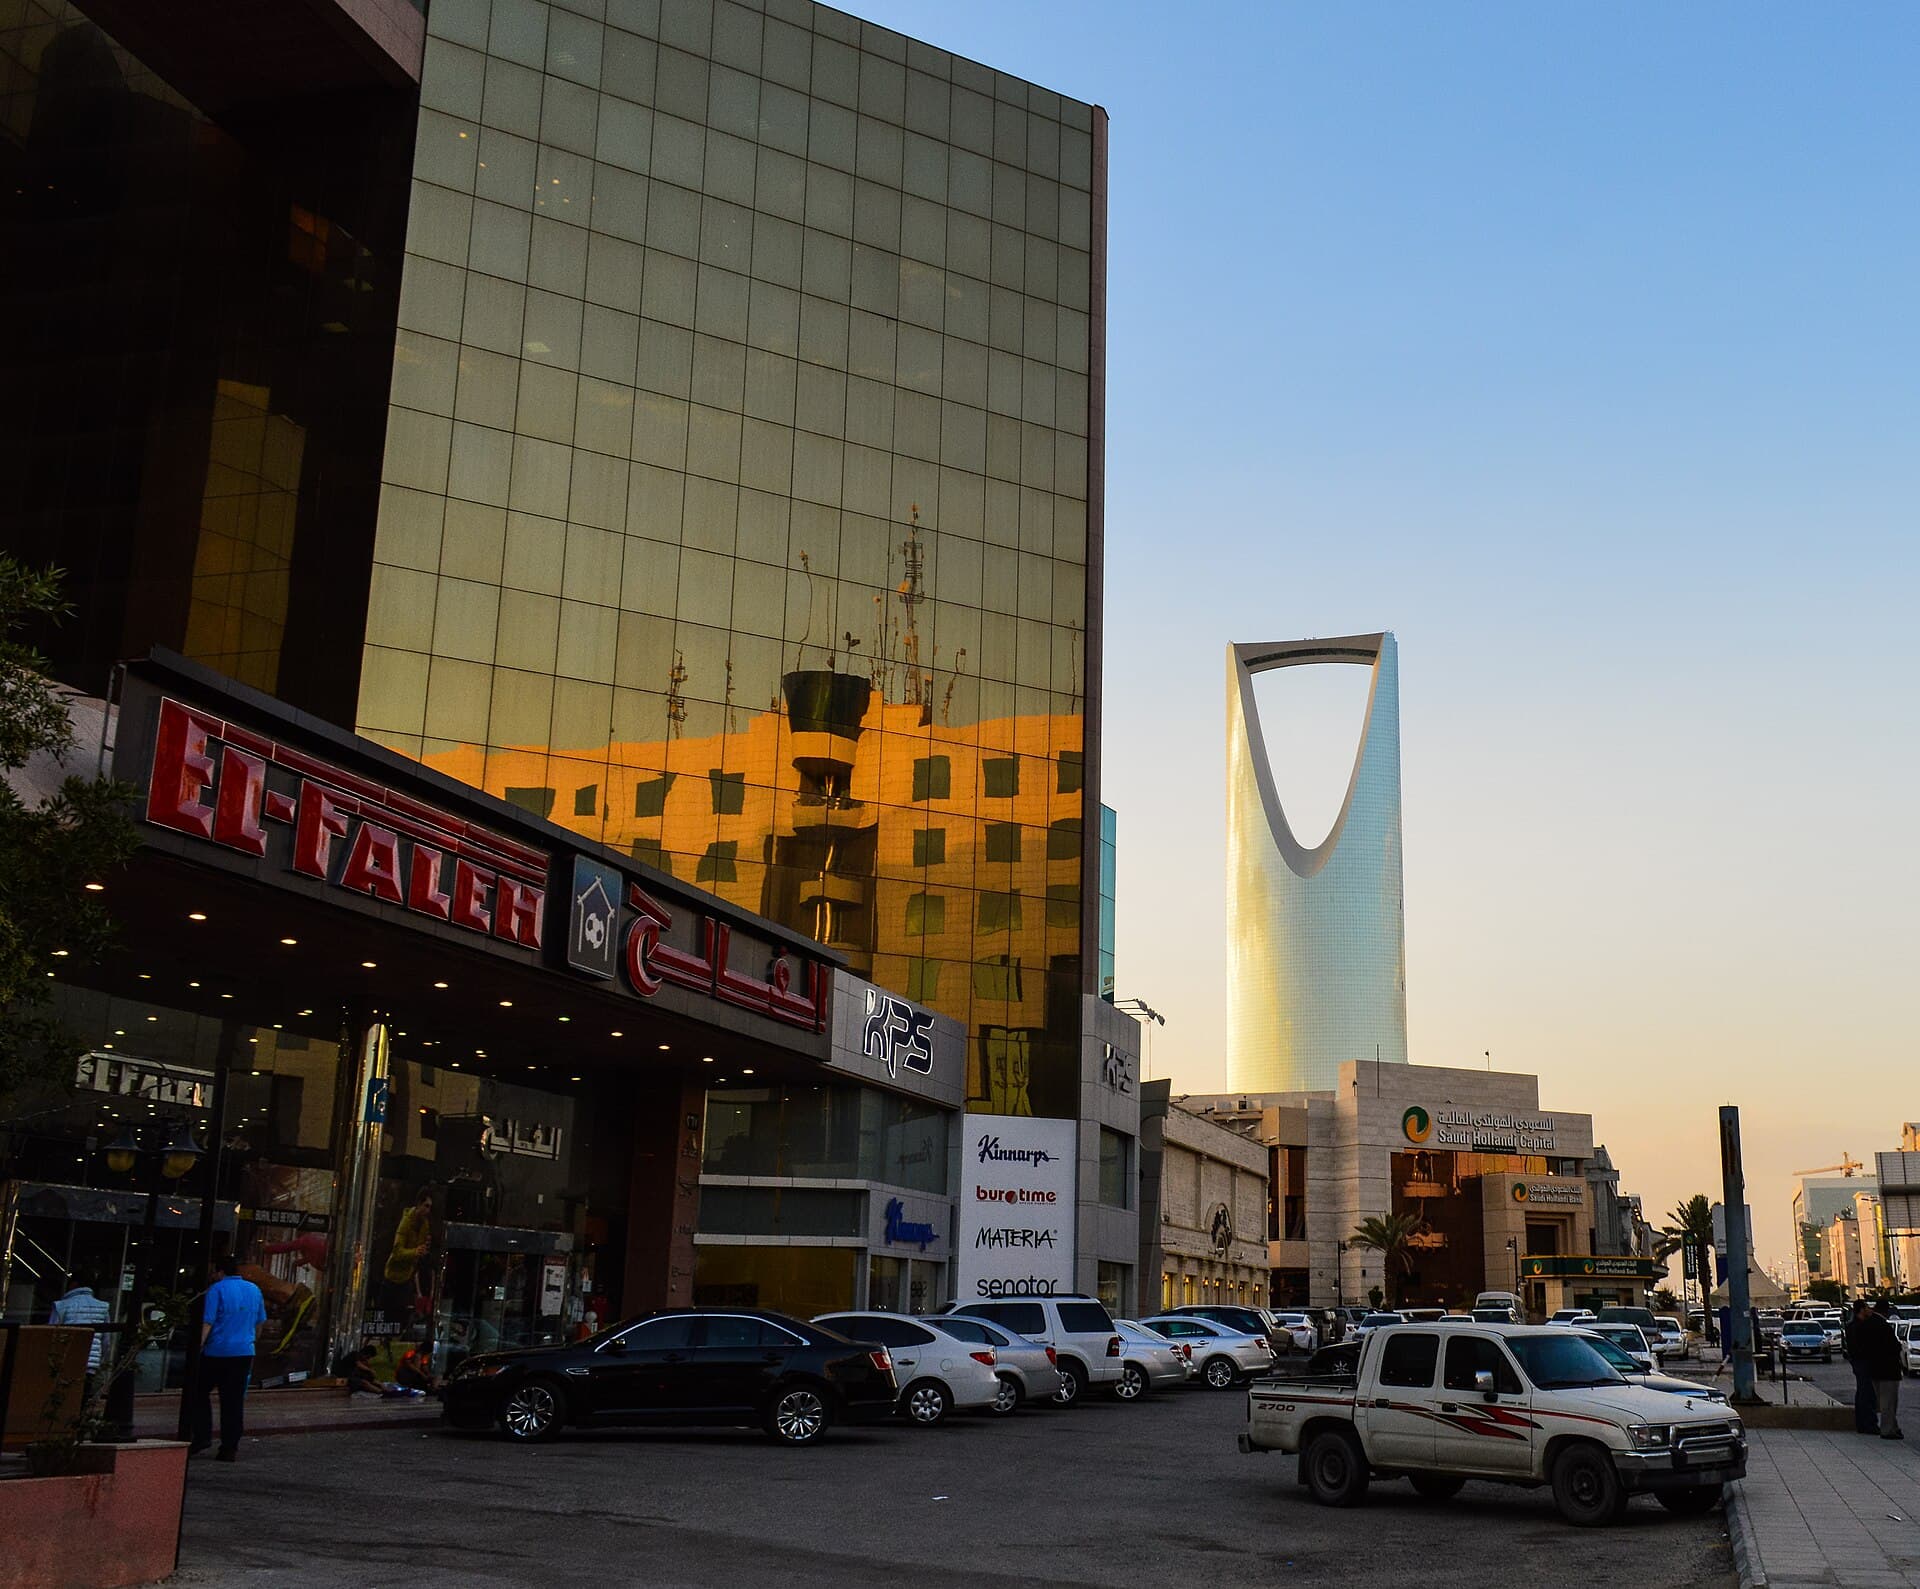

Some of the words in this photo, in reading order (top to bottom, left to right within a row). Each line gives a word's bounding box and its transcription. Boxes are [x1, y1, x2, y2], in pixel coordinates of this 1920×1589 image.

[146, 696, 549, 949] EL-FALEH
[627, 882, 827, 1034] الفالح
[863, 987, 936, 1080] KPS
[1438, 1111, 1472, 1128] المالية
[1515, 1115, 1556, 1133] السعودي
[977, 1134, 1060, 1168] Kinnarps
[1439, 1129, 1469, 1144] Saudi
[1473, 1130, 1517, 1147] Hollandi
[1519, 1135, 1556, 1151] Capital
[976, 1227, 1057, 1249] MATERIA
[1258, 1403, 1295, 1412] 2700
